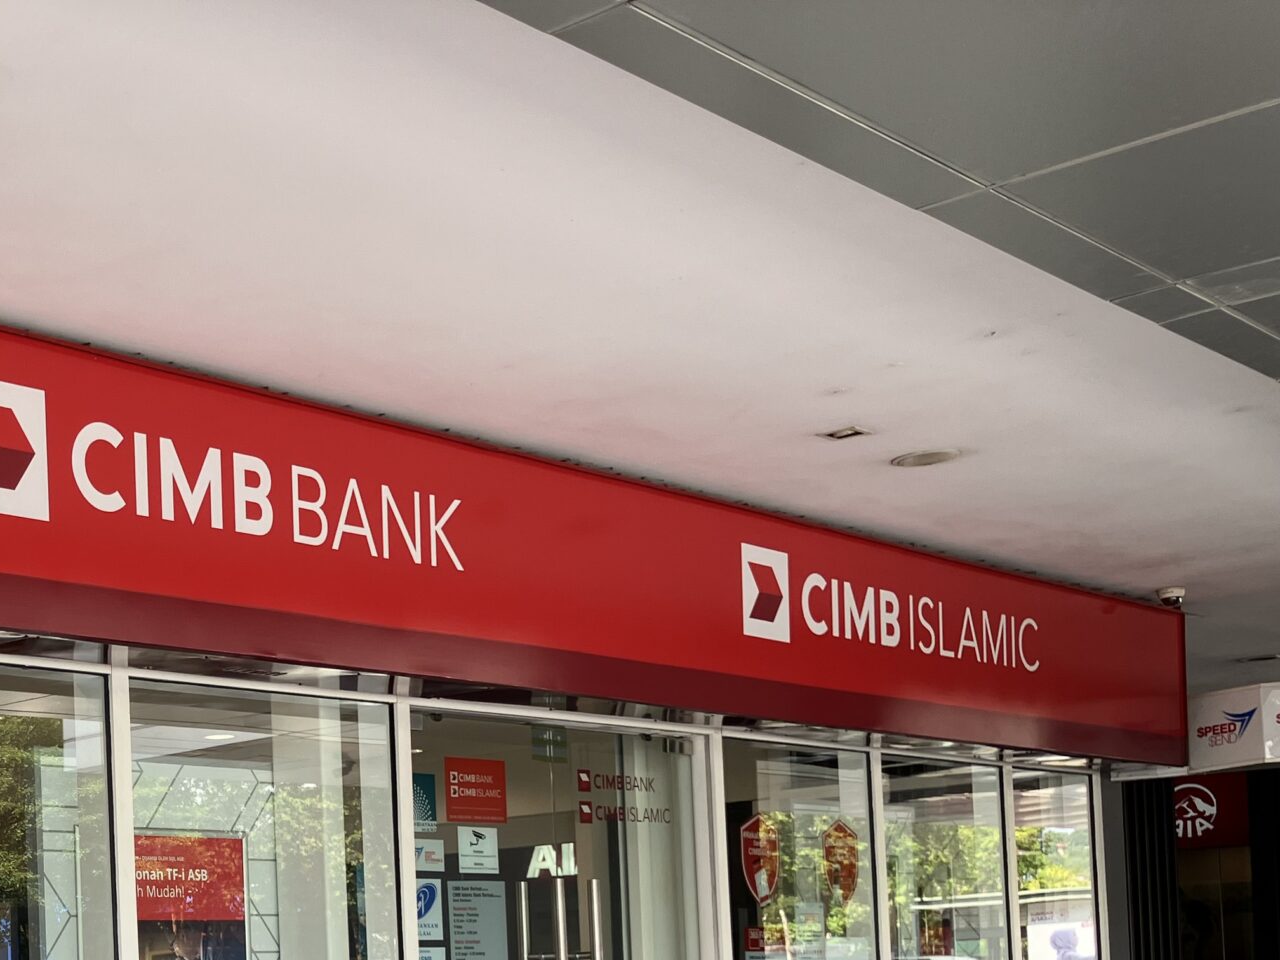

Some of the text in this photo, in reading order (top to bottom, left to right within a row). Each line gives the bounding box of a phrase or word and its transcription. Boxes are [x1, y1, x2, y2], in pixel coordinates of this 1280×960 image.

[71, 421, 464, 571] CIMB BANK
[801, 572, 1040, 672] CIMB ISLAMIC
[1196, 722, 1237, 738] SPEED
[1208, 733, 1238, 748] SEND
[459, 773, 476, 783] CIMB
[593, 773, 656, 793] CIMB BANK
[459, 788, 476, 797] CIMB
[595, 805, 671, 824] CIMB ISLAMIC
[135, 868, 208, 881] onah TF-i ASB
[146, 885, 185, 898] Mudah!
